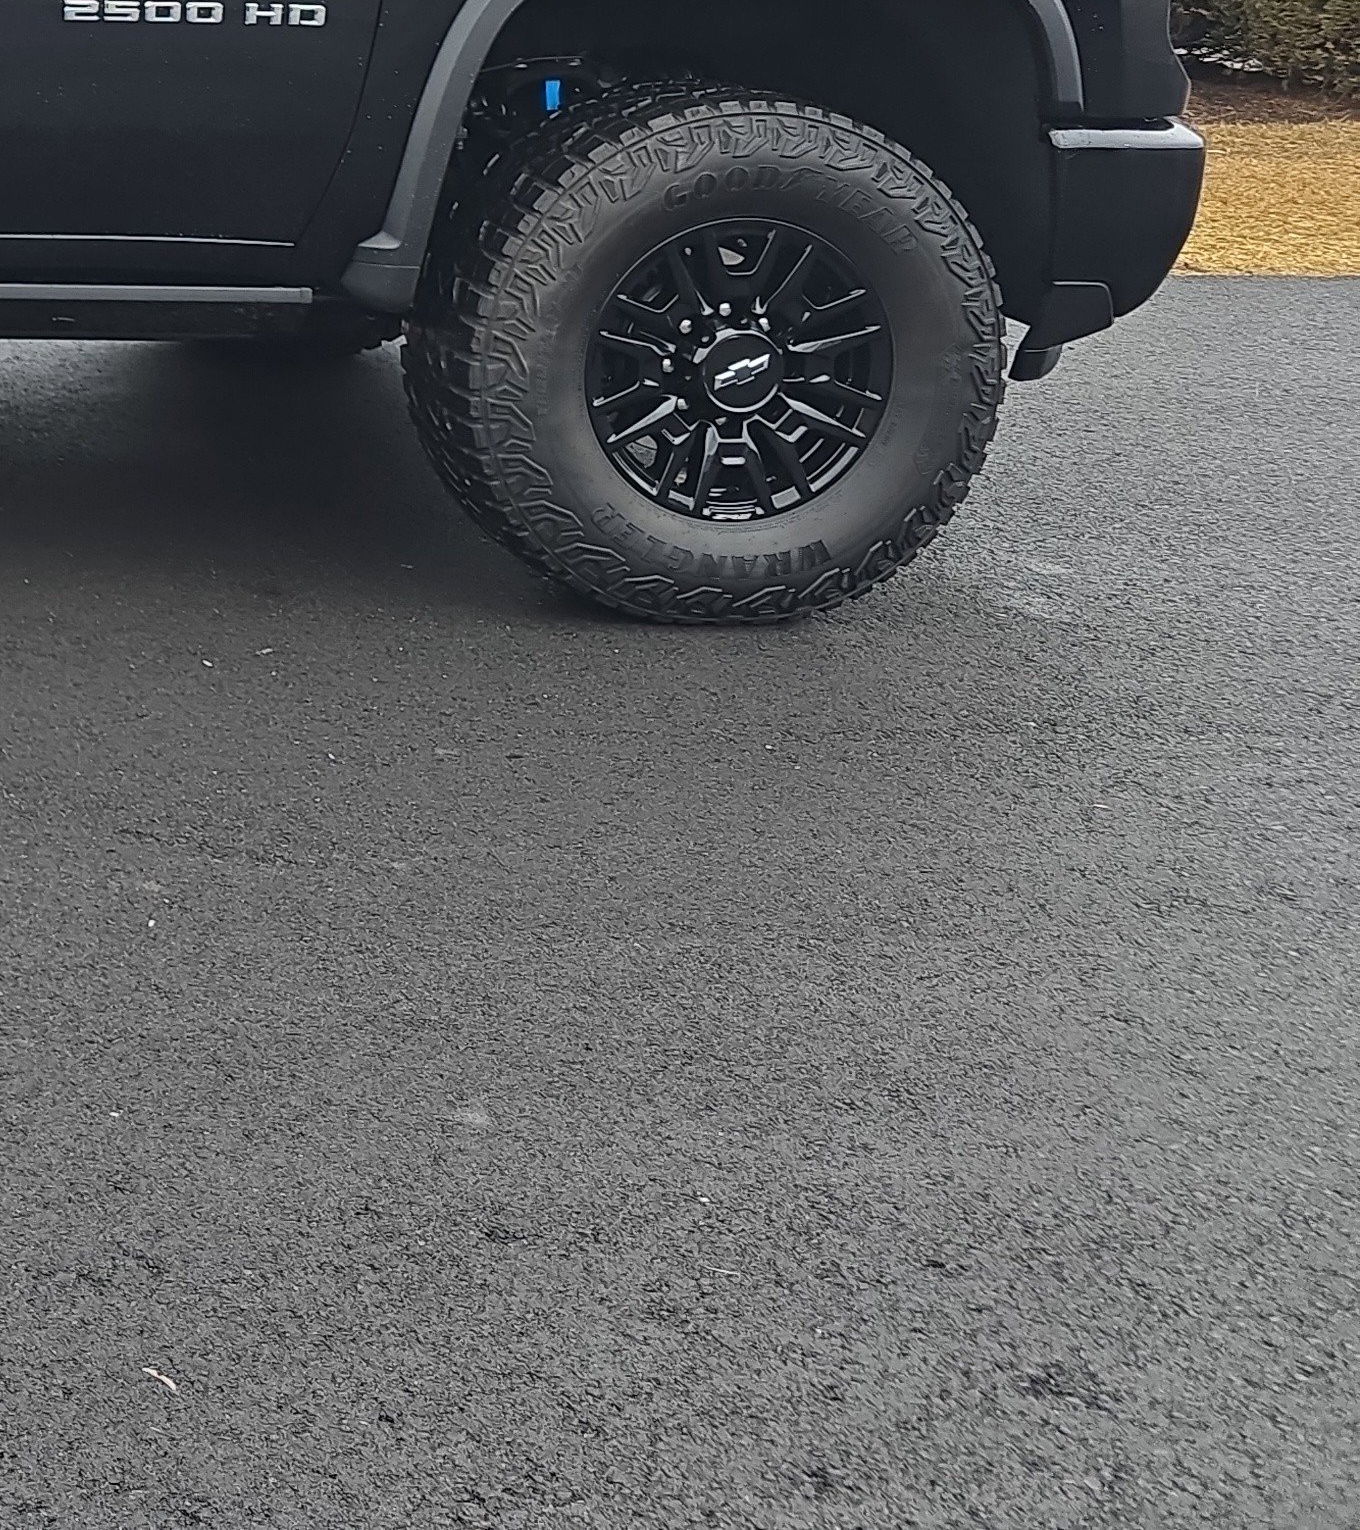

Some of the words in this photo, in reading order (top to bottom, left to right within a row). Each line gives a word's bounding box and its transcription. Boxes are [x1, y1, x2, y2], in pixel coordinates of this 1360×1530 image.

[63, 0, 224, 23] 2500
[244, 2, 327, 26] HD
[662, 164, 919, 256] GOODYEAR
[591, 502, 831, 580] WRANGLER
